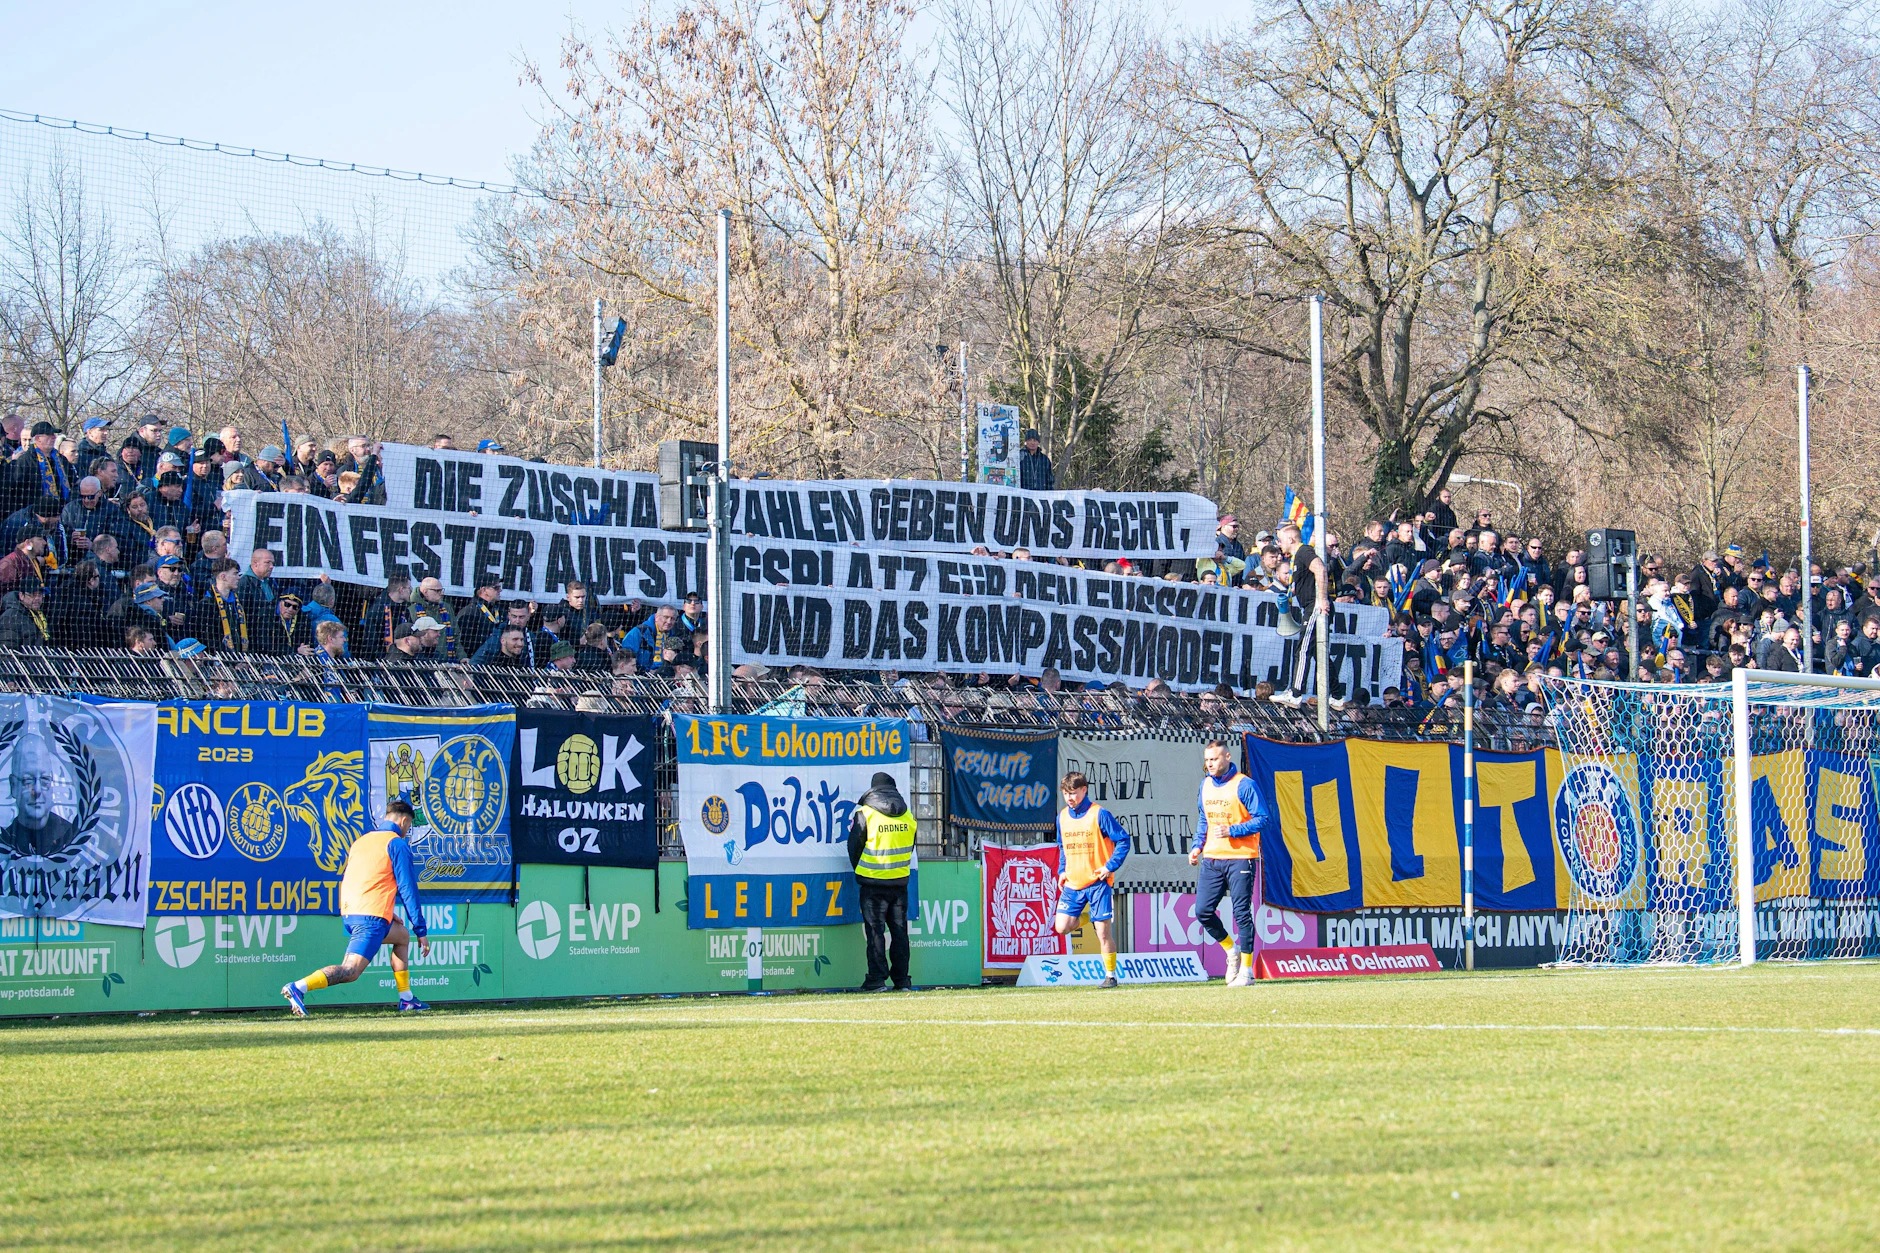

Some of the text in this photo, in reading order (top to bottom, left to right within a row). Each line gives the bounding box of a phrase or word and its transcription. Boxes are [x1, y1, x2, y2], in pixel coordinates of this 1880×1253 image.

[415, 457, 484, 513] DIE
[870, 488, 987, 545] GEBEN
[994, 495, 1076, 550] UNS
[1083, 498, 1191, 553] RECHT,
[253, 501, 345, 571] EIN
[348, 514, 536, 592] FESTER
[543, 531, 928, 601] AUFSTIGSPLATZ
[740, 592, 832, 659] UND
[842, 599, 929, 660] DAS
[937, 603, 1258, 691] KOMPASSMODELL
[1266, 638, 1382, 698] JZT!
[157, 703, 326, 737] ANCLUB
[686, 719, 902, 758] 1.FC Lokomotive
[198, 746, 254, 763] 2023
[953, 747, 1033, 776] RESOLUTE
[475, 781, 501, 832] LEIPZIG
[520, 794, 645, 822] HALUNKEN
[976, 781, 1051, 813] JUGEND
[167, 785, 221, 856] VfB
[229, 805, 284, 857] LOKOMOTIVE LEIPZIG
[878, 822, 909, 834] ORDNER
[1064, 830, 1086, 838] CRAFT
[410, 833, 512, 866] -LOKIST
[418, 855, 467, 883] Jena
[1015, 866, 1036, 883] FC
[256, 877, 341, 914] LOKIST
[704, 880, 843, 919] LEIPZ
[1009, 882, 1042, 899] RWE
[1, 917, 80, 938] MIT UNS
[215, 915, 298, 949] EWP
[569, 902, 641, 941] EWP
[1326, 916, 1428, 949] FOOTBALL
[569, 944, 640, 955] Stadtwerke Potsdam
[709, 934, 739, 958] HAT
[942, 938, 969, 948] Potsdam
[991, 937, 1019, 955] HOCH
[1020, 938, 1031, 955] IN
[0, 947, 111, 977] AT ZUKUNFT
[215, 952, 297, 964] Stadtwerke Potsdam
[1067, 956, 1200, 981] SEEBD-APOTHEKE
[1276, 947, 1430, 975] nahkauf Oelmann
[0, 985, 76, 1001] wp-potsdam.de
[379, 974, 450, 989] ewptsdam.de
